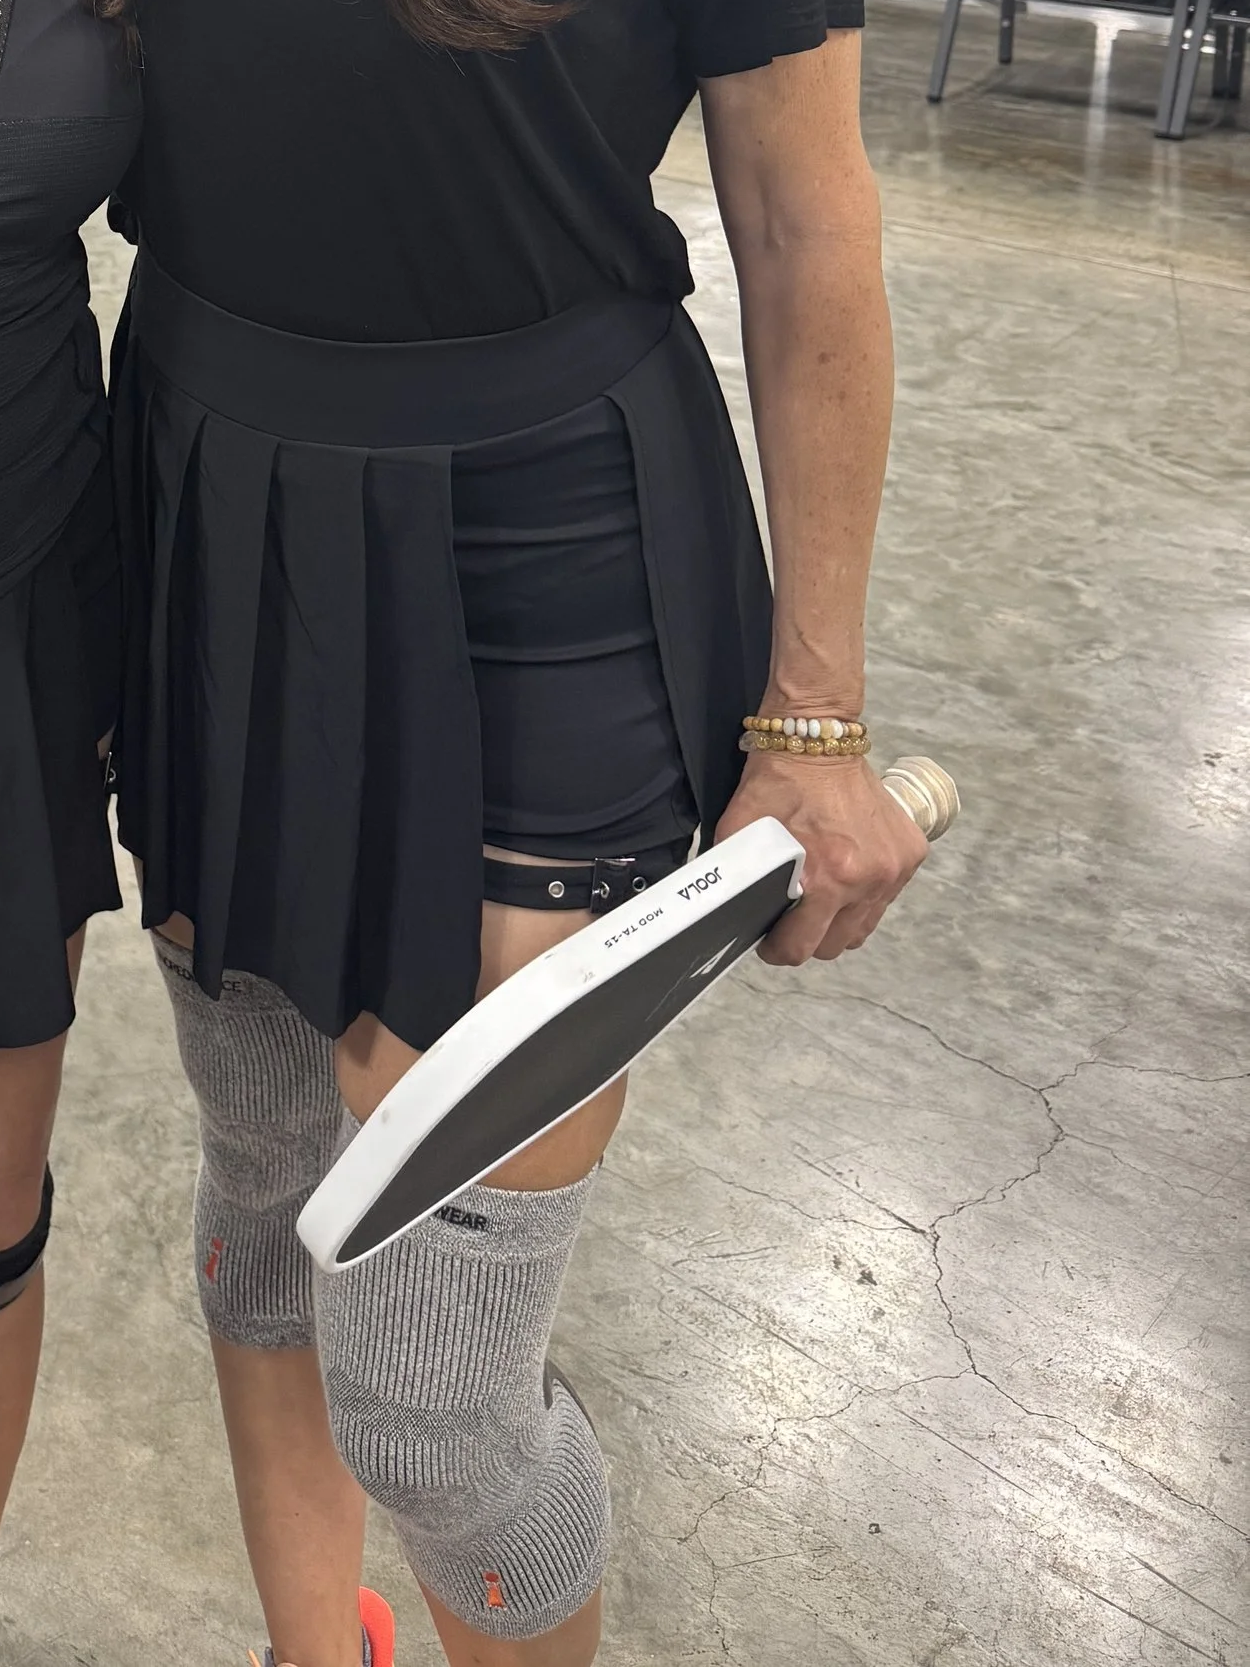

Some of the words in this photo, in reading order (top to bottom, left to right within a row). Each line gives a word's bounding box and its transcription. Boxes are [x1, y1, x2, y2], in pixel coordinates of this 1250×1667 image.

[676, 866, 723, 901] JOOLA
[638, 907, 664, 927] MOD
[603, 925, 639, 949] TA-15
